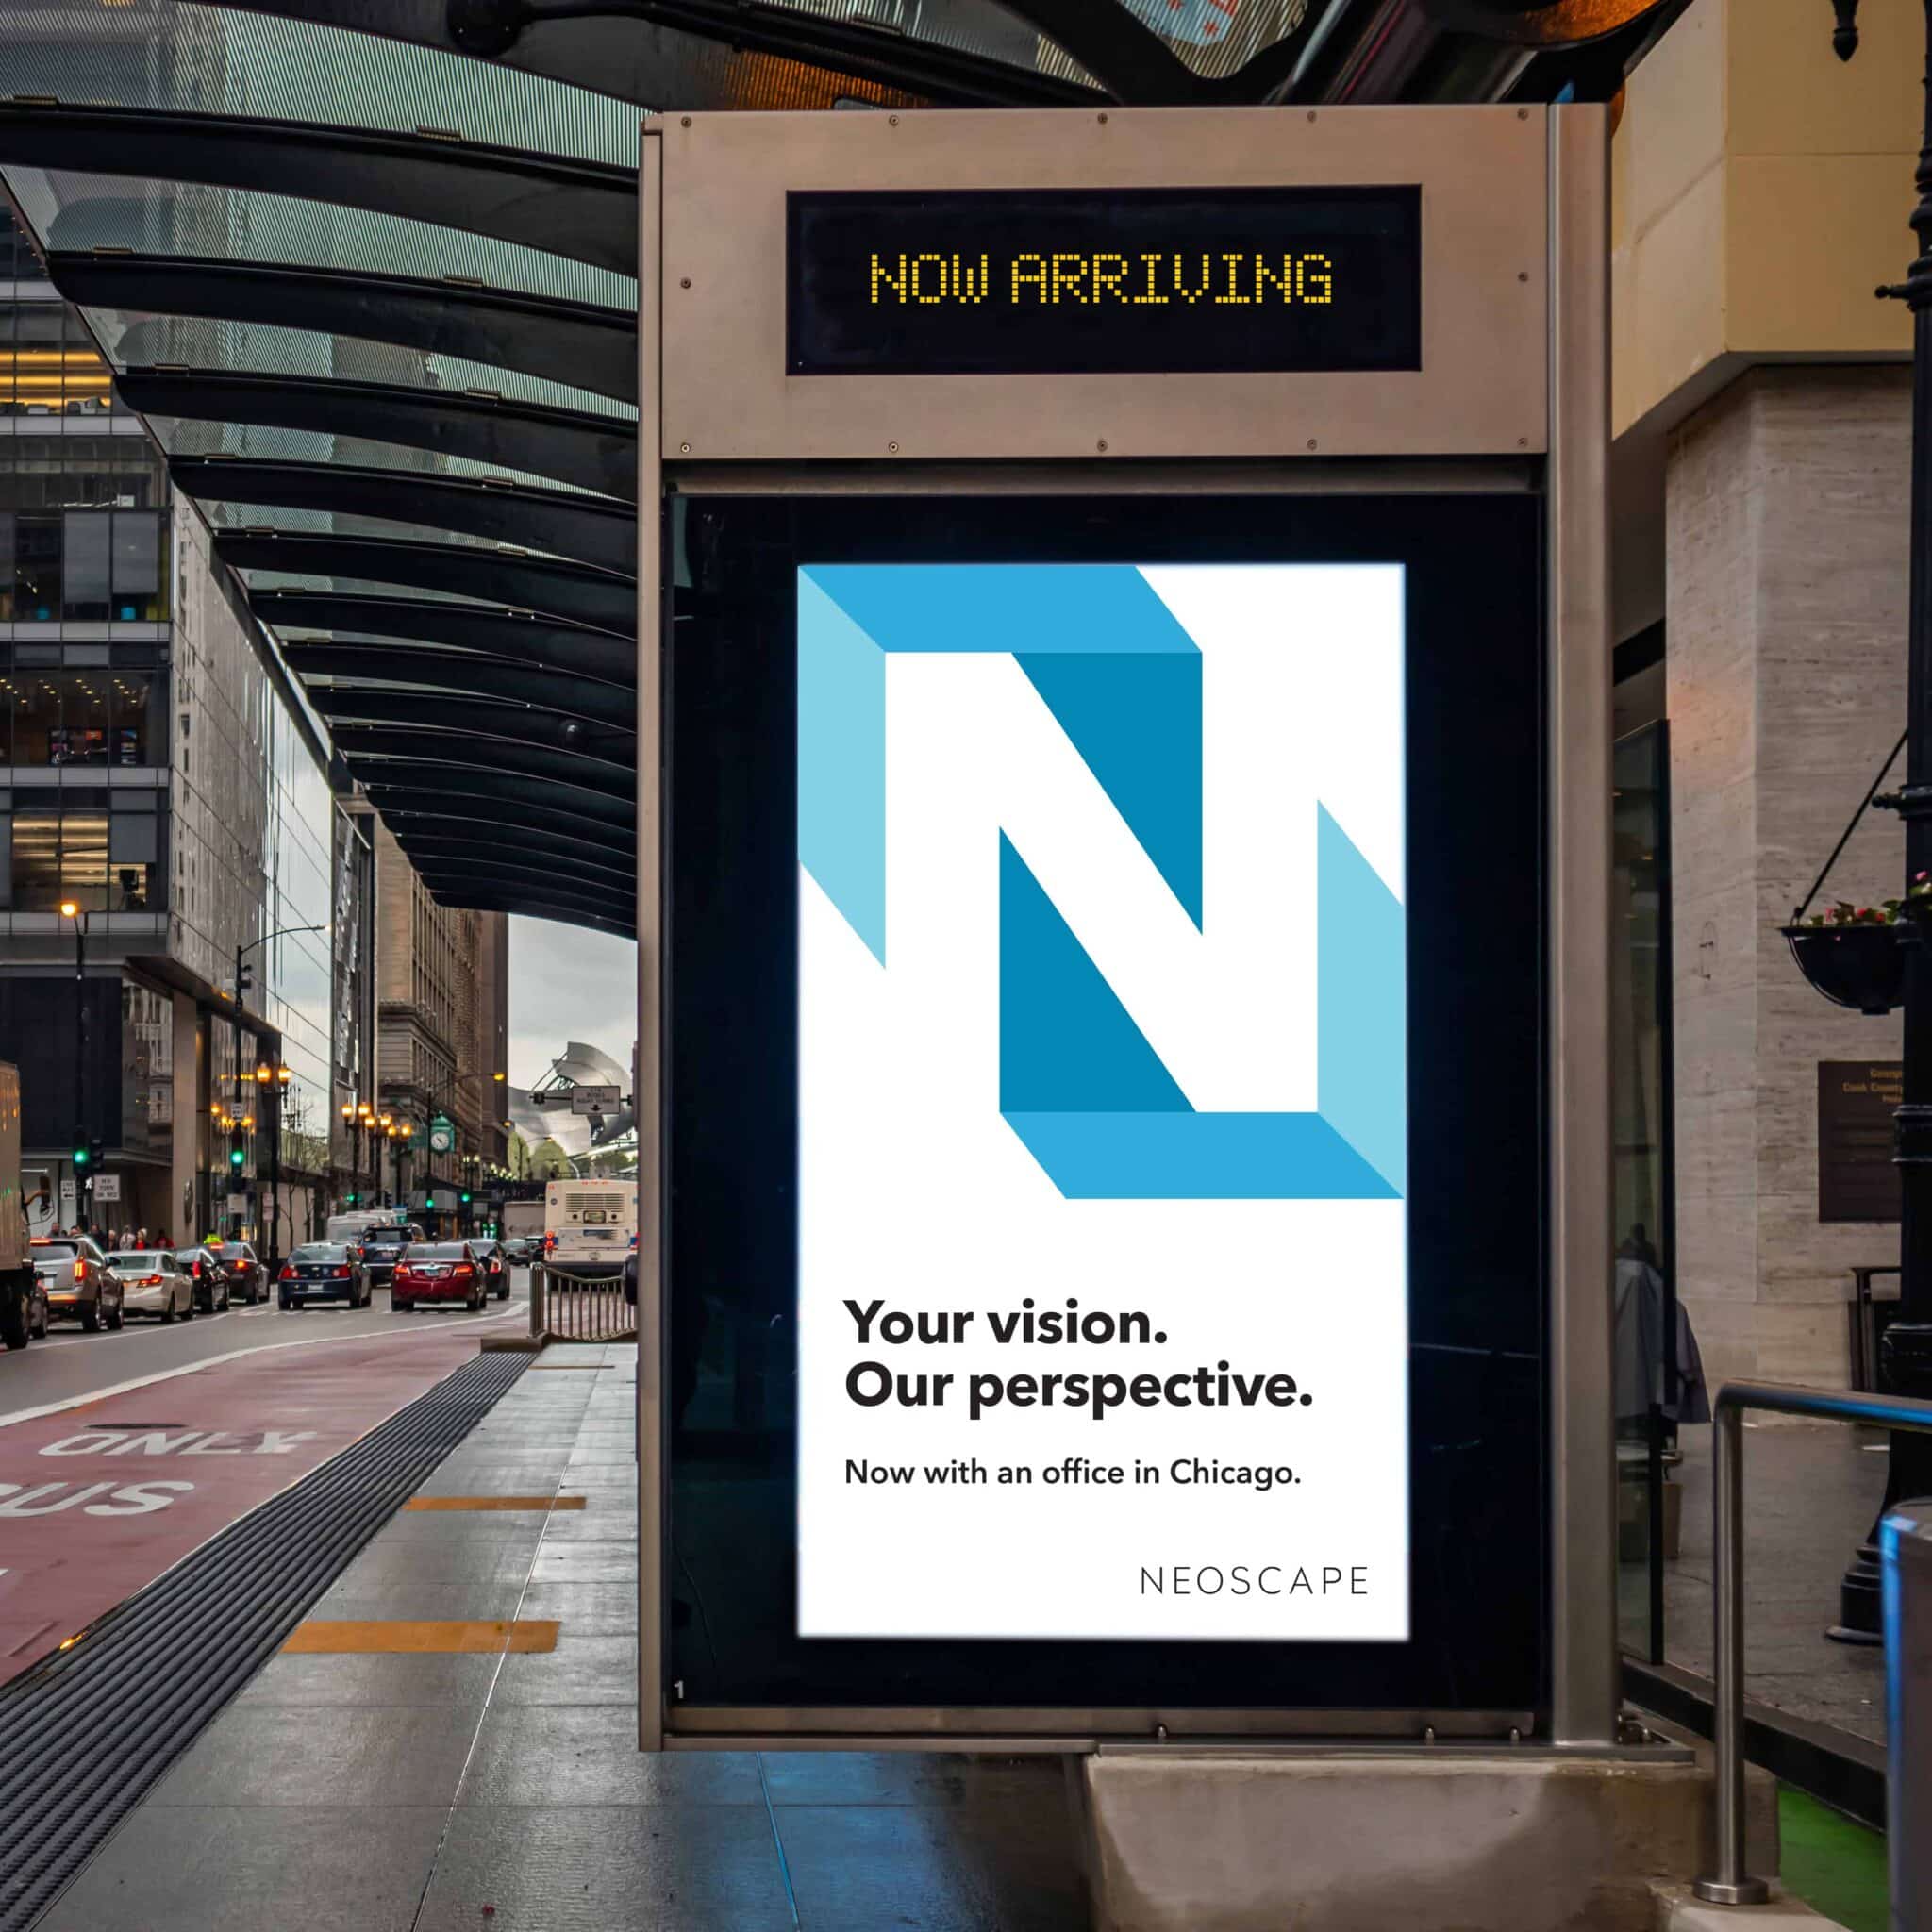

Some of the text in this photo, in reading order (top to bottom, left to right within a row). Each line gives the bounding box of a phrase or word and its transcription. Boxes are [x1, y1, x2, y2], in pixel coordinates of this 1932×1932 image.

[871, 254, 1332, 304] NOW ARRIVING
[843, 1297, 1168, 1344] Your vision.
[845, 1359, 1313, 1421] Our perspective.
[38, 1432, 318, 1457] ONLY
[845, 1457, 1301, 1491] Now with an office in Chicago.
[0, 1480, 195, 1517] US
[1141, 1566, 1369, 1595] NEOSCAPE
